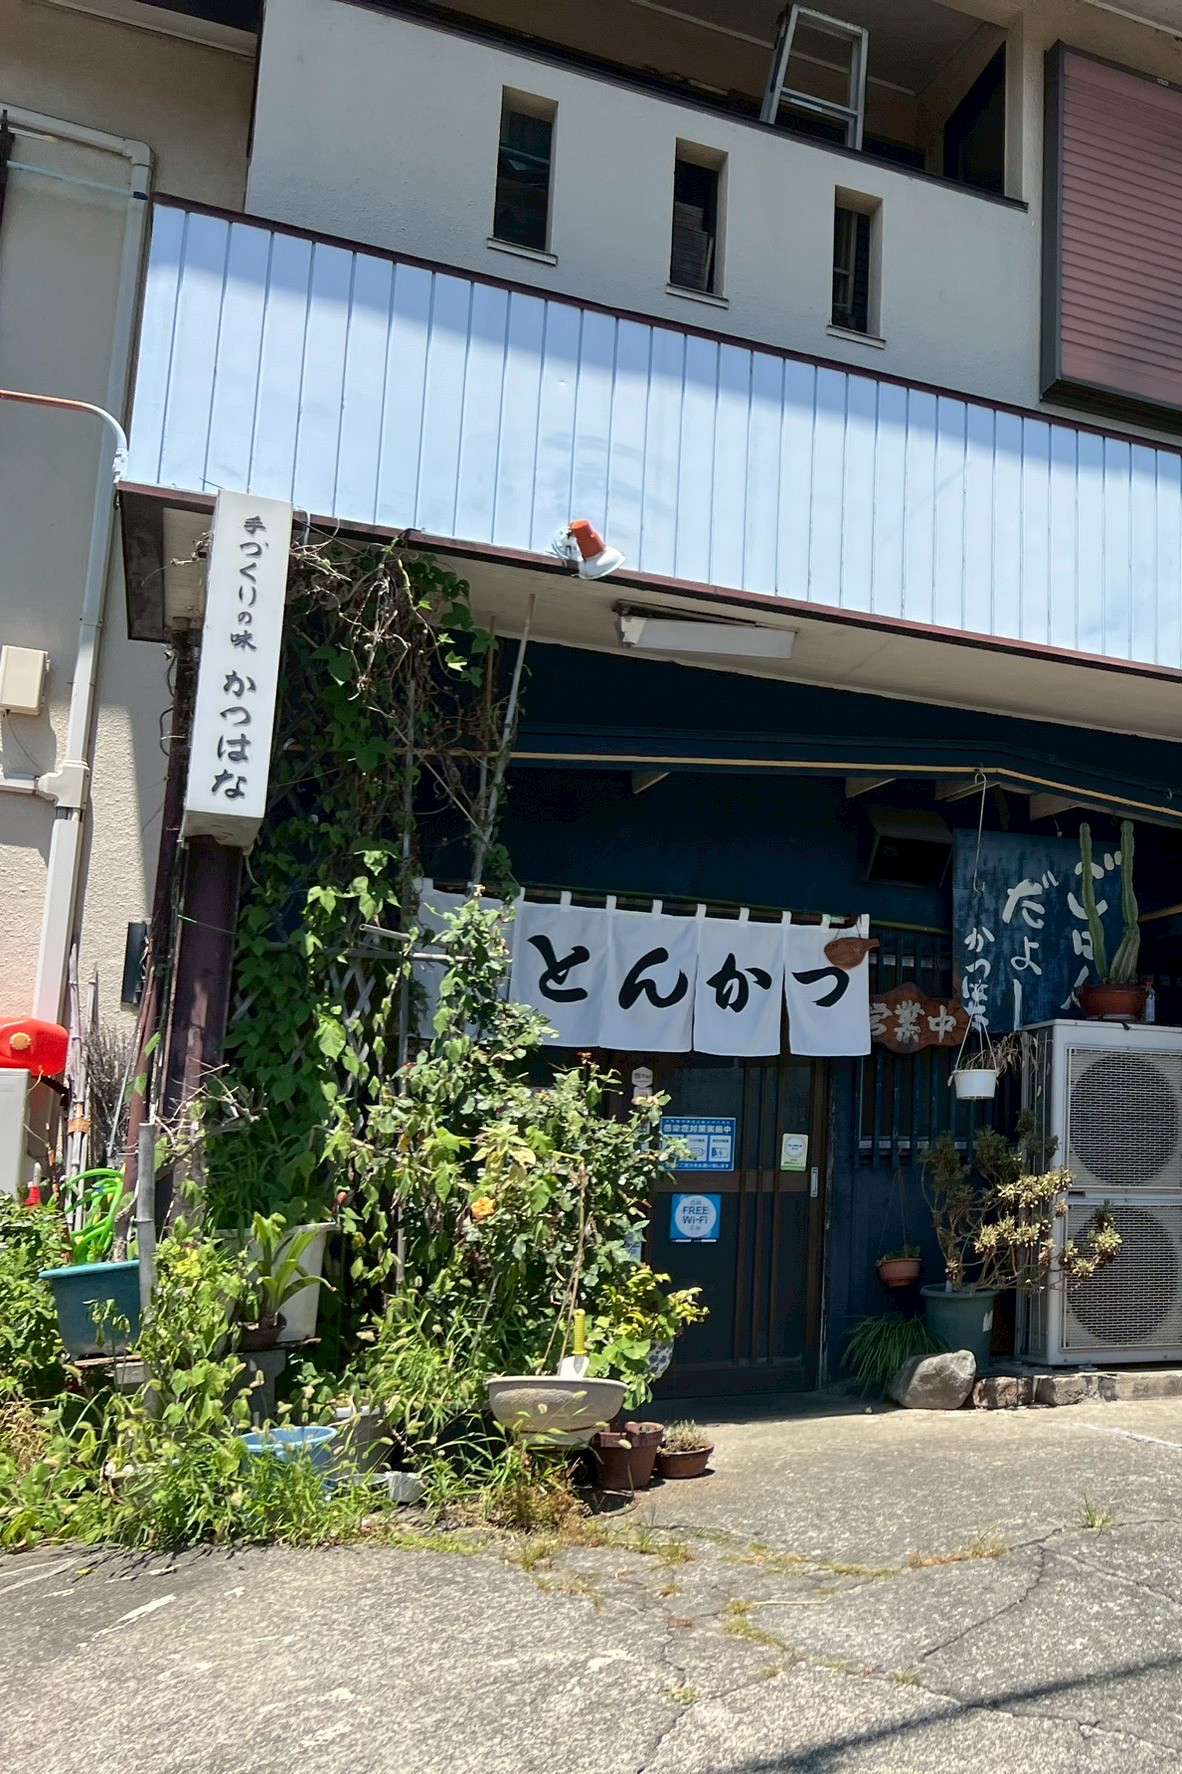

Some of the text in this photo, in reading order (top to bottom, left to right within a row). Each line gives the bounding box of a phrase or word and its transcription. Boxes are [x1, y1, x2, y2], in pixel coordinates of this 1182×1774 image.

[211, 515, 270, 799] 手づくりの味 かつはな
[527, 934, 850, 1013] とんかつ
[962, 926, 996, 1032] かつはな
[1002, 870, 1059, 1031] だよー
[682, 1206, 709, 1215] FREE
[682, 1215, 708, 1224] Wi-Fi
